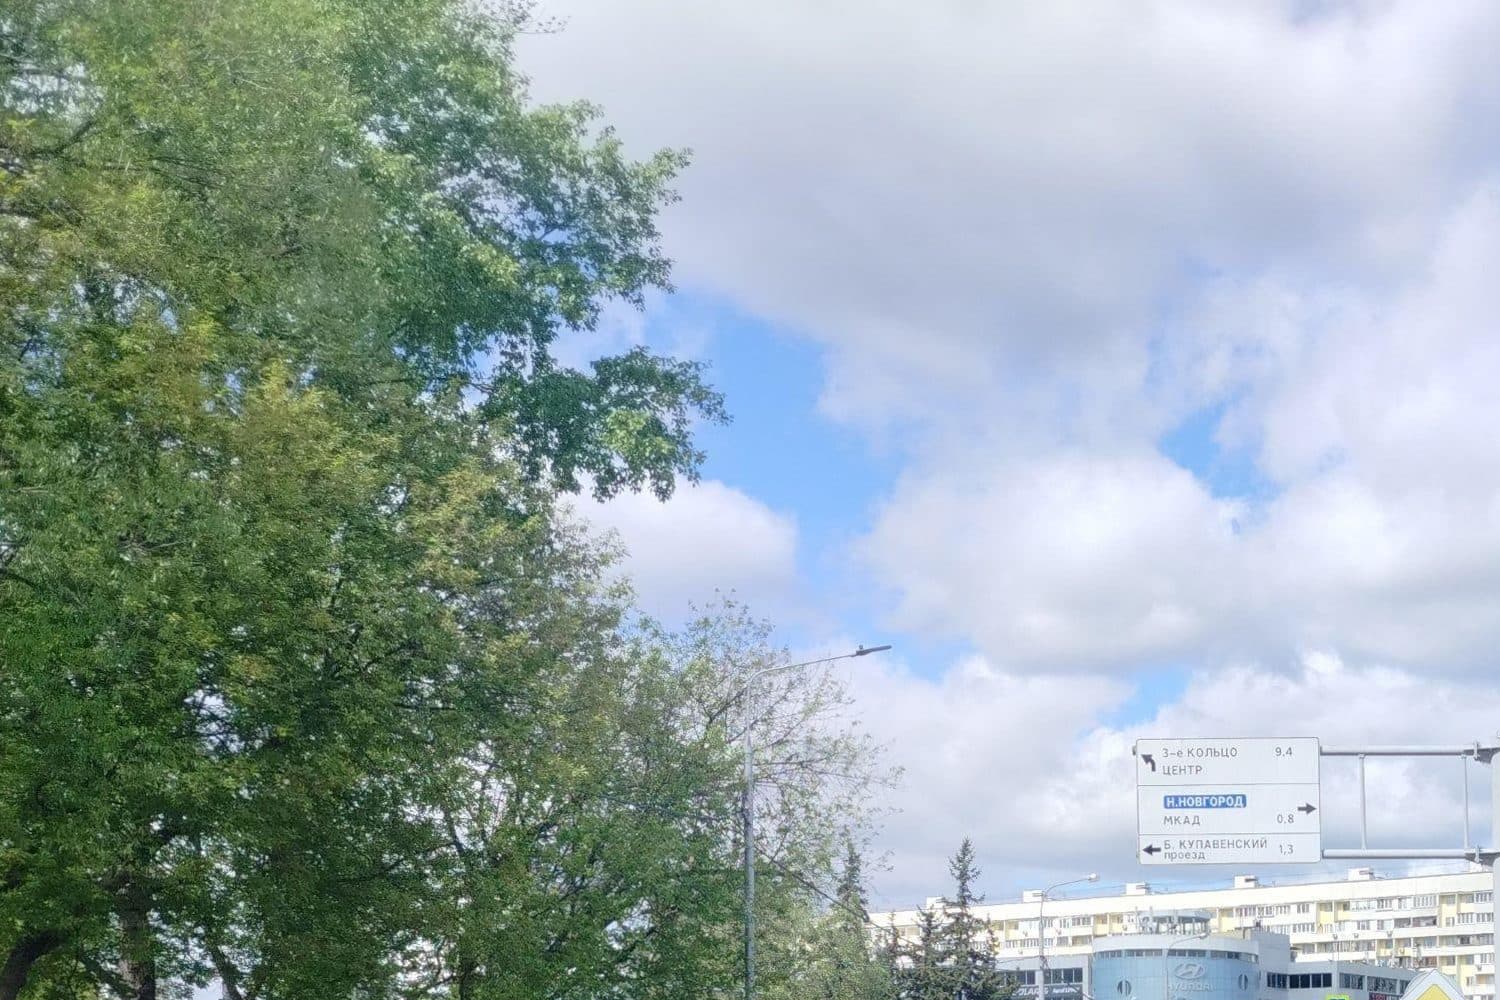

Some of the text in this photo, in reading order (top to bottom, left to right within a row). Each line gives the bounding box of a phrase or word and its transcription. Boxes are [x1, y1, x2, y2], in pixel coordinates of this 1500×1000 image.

[1187, 747, 1238, 759] КОЛЬЦО
[1162, 765, 1203, 777] ЦЕНТР
[1166, 796, 1245, 808] Н.НОВГОРОД
[1163, 815, 1201, 826] МКАД
[1164, 840, 1175, 850] Б.
[1179, 838, 1268, 850] КУПАВЕНСКИЙ
[1164, 851, 1206, 862] проезд
